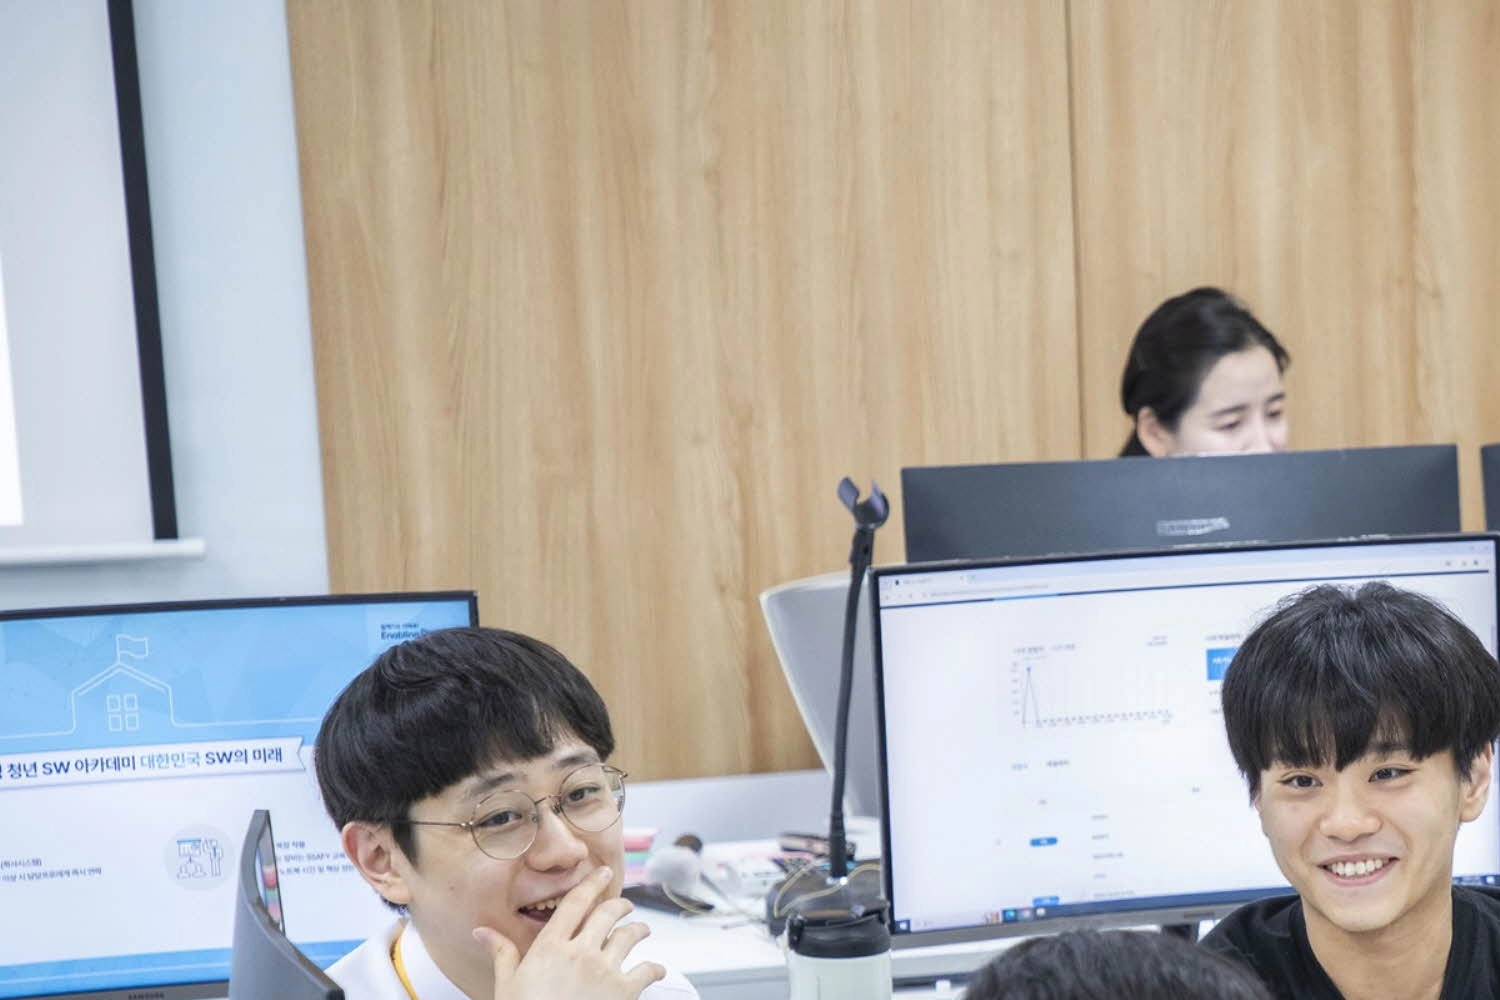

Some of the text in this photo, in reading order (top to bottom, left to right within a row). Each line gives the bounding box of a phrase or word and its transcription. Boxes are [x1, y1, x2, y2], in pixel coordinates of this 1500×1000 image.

[8, 760, 38, 779] 청년
[42, 761, 71, 775] SW
[75, 755, 136, 774] 아카데미
[140, 751, 201, 769] 대한민국
[205, 749, 249, 765] SW의
[252, 747, 283, 764] 미래
